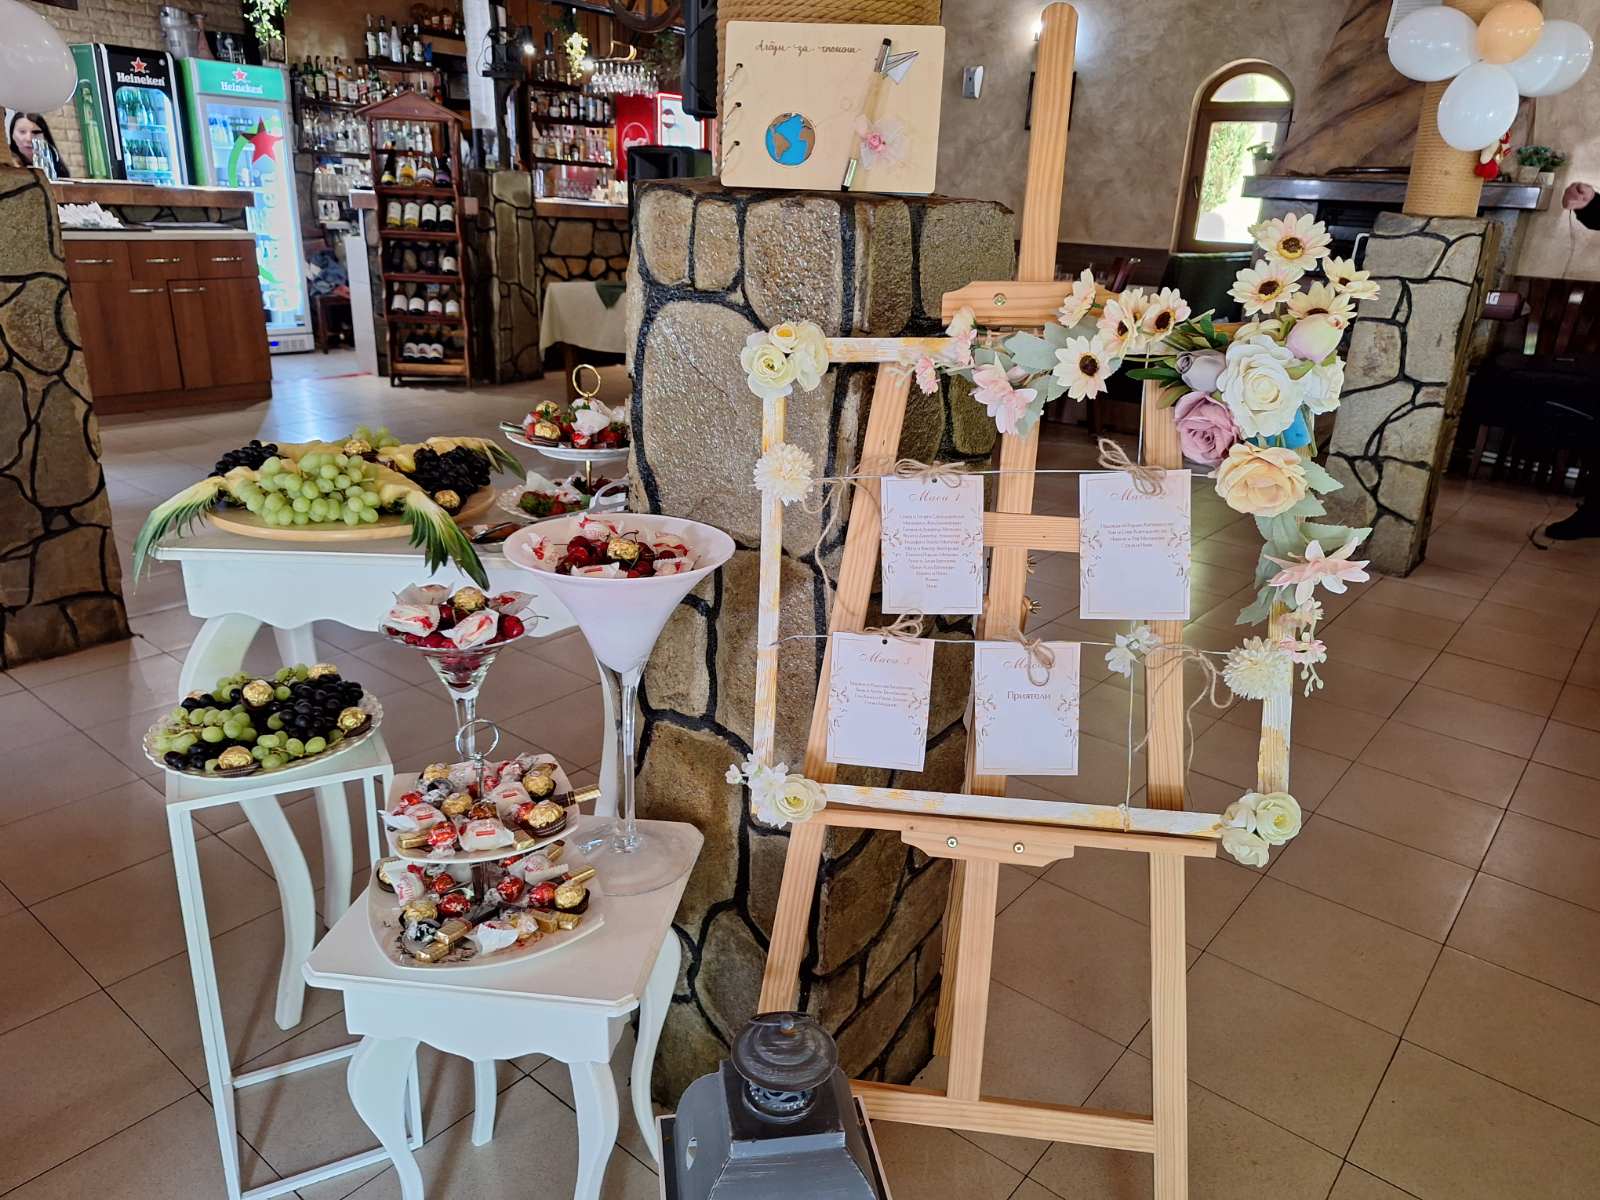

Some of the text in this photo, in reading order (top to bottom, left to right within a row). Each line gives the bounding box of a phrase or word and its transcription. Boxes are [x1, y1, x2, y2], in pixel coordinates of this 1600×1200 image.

[116, 72, 166, 87] Heineken
[221, 81, 264, 94] Heineken
[1007, 689, 1051, 701] Приятели
